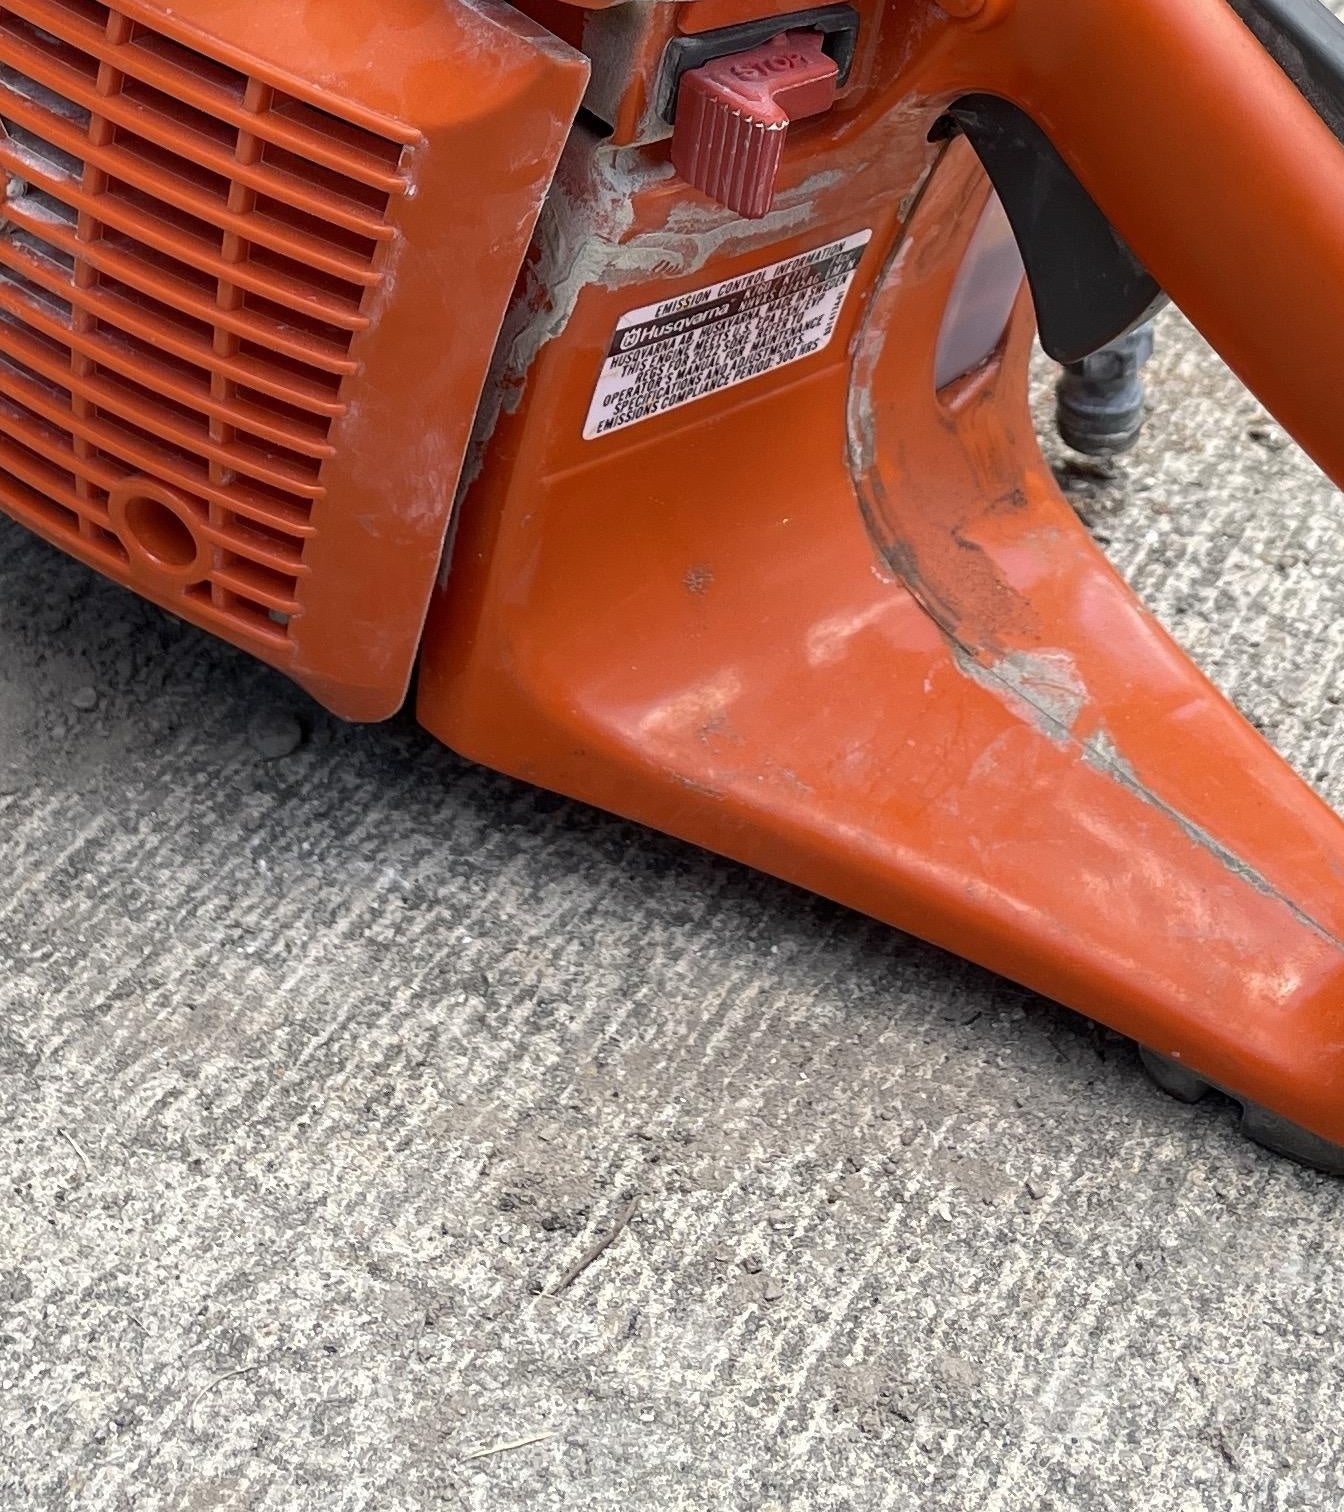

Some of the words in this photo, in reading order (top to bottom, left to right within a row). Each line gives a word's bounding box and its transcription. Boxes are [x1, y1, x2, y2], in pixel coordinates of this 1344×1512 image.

[729, 53, 809, 83] STOP
[655, 289, 711, 317] EMISSION
[718, 269, 767, 296] CONTROL
[775, 241, 844, 276] INFORMATION
[610, 336, 677, 369] HUSQVARNA
[766, 295, 794, 313] MADE
[809, 273, 848, 297] SWEDEN
[621, 358, 647, 377] THIS
[651, 344, 690, 366] ENGINE
[694, 330, 729, 351] MEETS
[756, 312, 776, 328] EPA
[636, 363, 665, 383] REGS
[668, 355, 689, 371] FOR
[692, 344, 720, 363] 2022
[757, 319, 787, 338] REFER
[791, 312, 804, 324] TO
[639, 299, 731, 344] Husqvarna
[677, 355, 722, 379] MANUAL
[726, 346, 744, 361] FOR
[751, 315, 823, 351] MAINTENANCE
[597, 400, 659, 433] EMISSIONS
[662, 374, 730, 408] COMPLIANCE
[777, 348, 797, 363] 300
[614, 373, 702, 415] SPECIFICATIONS
[706, 364, 727, 380] AND
